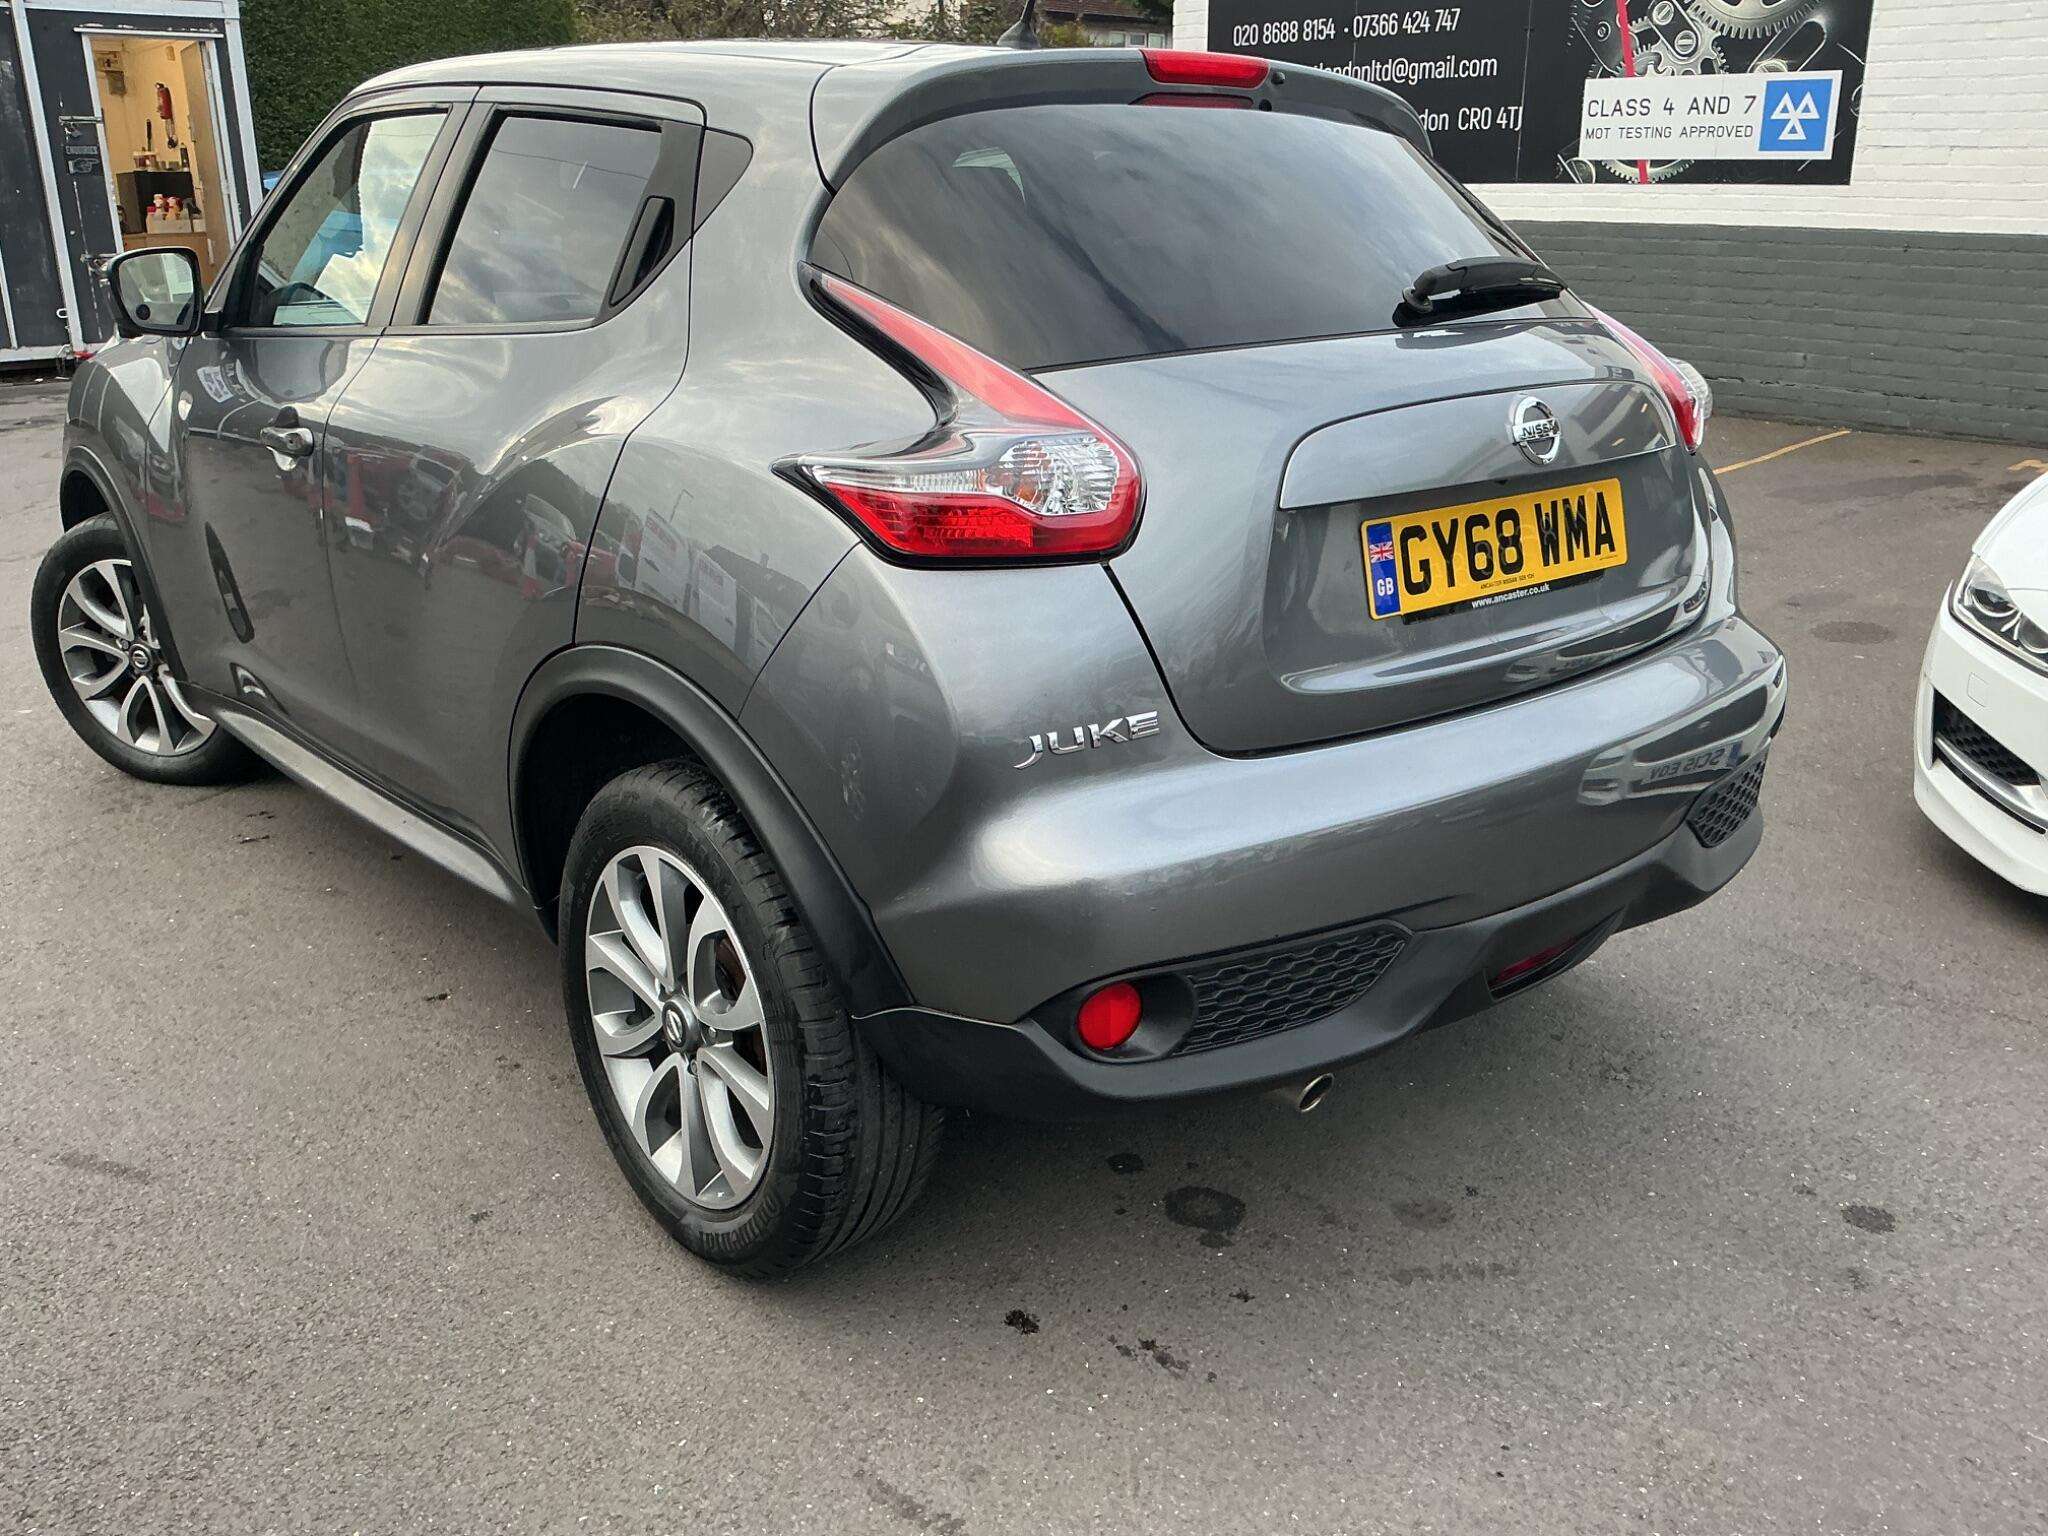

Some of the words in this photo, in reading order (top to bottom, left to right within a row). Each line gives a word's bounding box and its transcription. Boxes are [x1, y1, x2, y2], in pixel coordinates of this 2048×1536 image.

[1233, 23, 1259, 46] 020
[1262, 20, 1299, 44] 8688
[1302, 17, 1336, 41] 8154
[1353, 13, 1398, 38] 07366
[1402, 10, 1430, 34] 424
[1434, 8, 1461, 32] 747
[1496, 106, 1523, 131] 4TJ
[1587, 98, 1651, 117] CLASS
[1663, 97, 1675, 115] 4
[1687, 95, 1731, 115] AND
[1744, 95, 1757, 114] 7
[1585, 127, 1611, 140] MOT
[1618, 126, 1672, 139] TESTING
[1679, 125, 1754, 138] APPROVED
[1399, 507, 1524, 596] GY68
[1534, 491, 1617, 567] WMA
[1377, 577, 1395, 597] GB
[1471, 582, 1550, 609] www.ancaster.co.uk
[1012, 710, 1160, 770] JUKE
